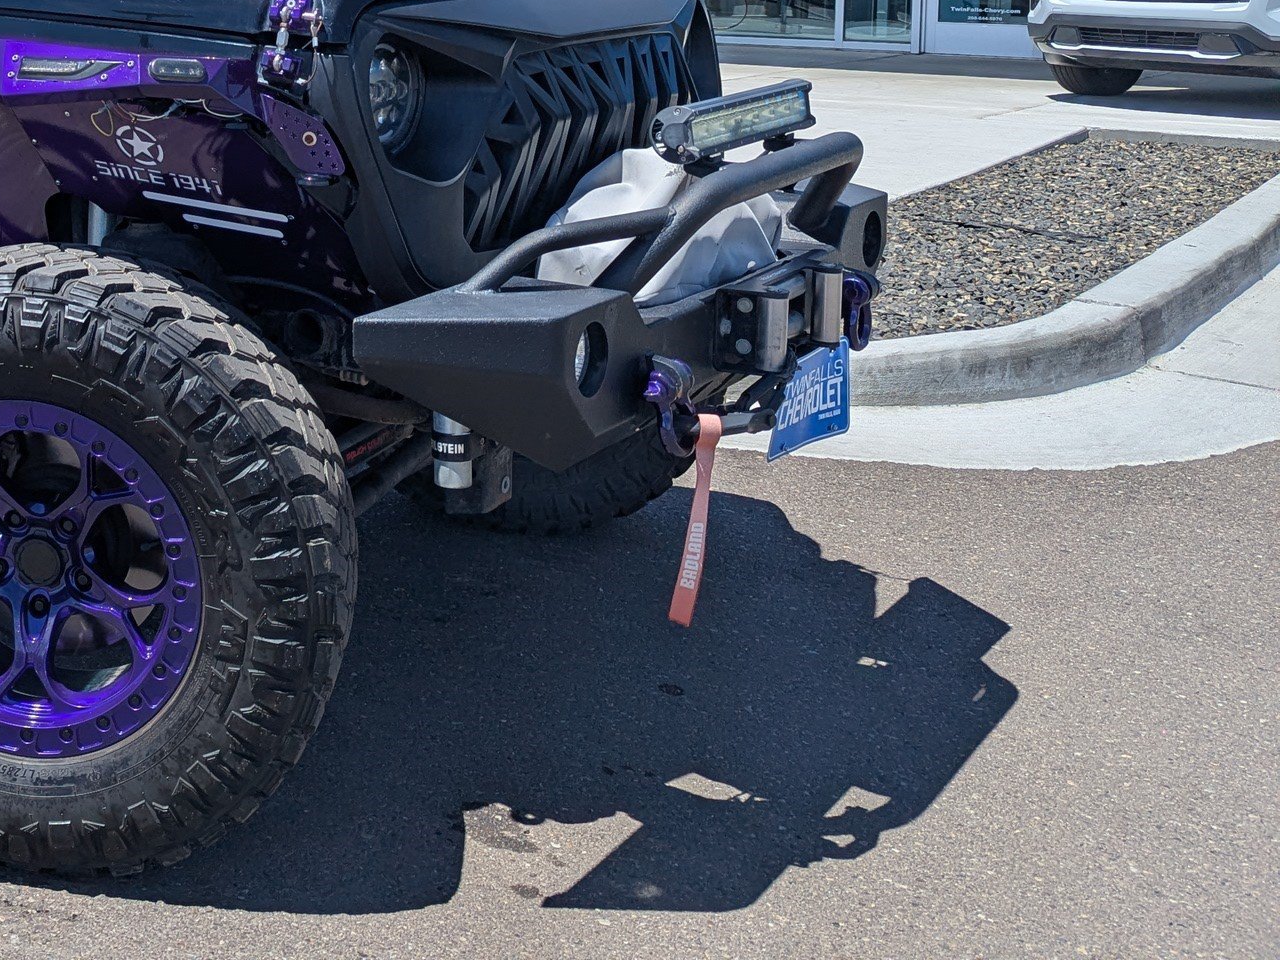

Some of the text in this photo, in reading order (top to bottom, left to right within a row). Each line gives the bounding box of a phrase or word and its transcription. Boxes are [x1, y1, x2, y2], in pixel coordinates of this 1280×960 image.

[169, 172, 223, 195] 1941
[778, 376, 843, 431] CHEVROLET
[680, 522, 704, 589] BADLAND
